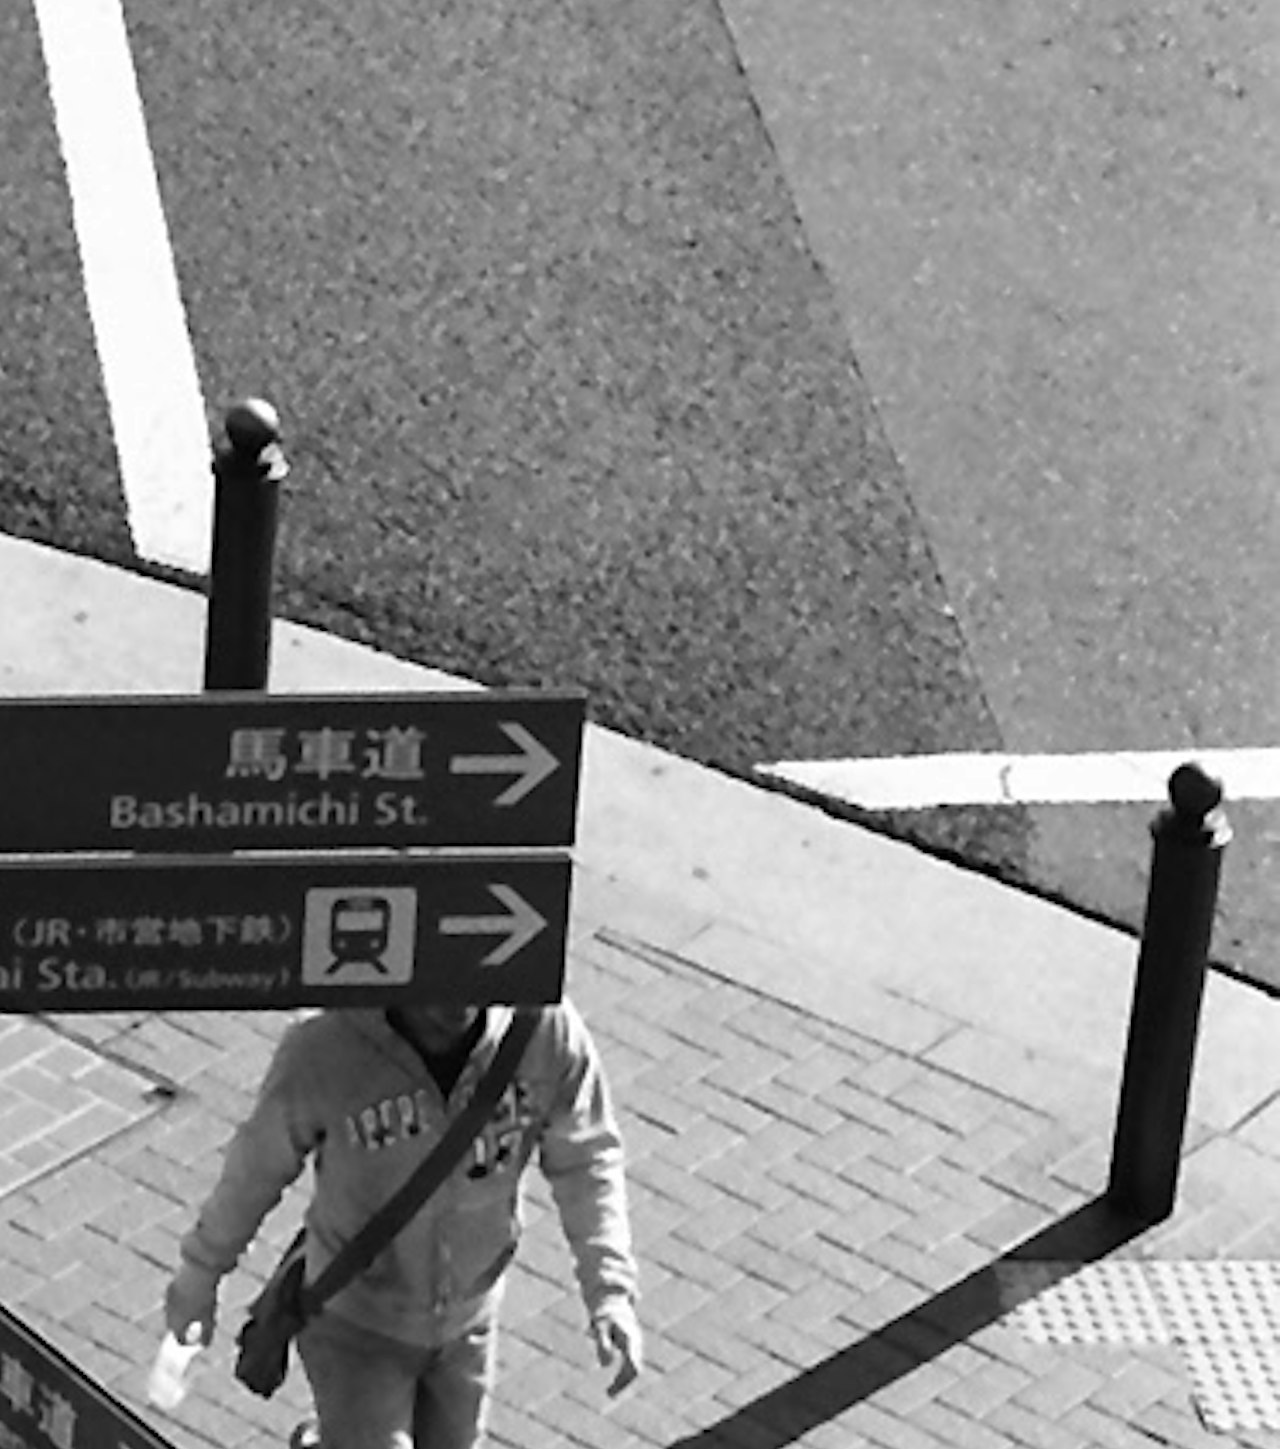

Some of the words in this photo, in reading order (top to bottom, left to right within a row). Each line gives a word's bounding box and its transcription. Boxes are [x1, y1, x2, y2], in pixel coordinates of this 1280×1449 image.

[225, 726, 427, 782] 馬車道
[109, 790, 360, 829] Bashamichi
[374, 790, 428, 828] St.
[38, 956, 117, 992] Sta.
